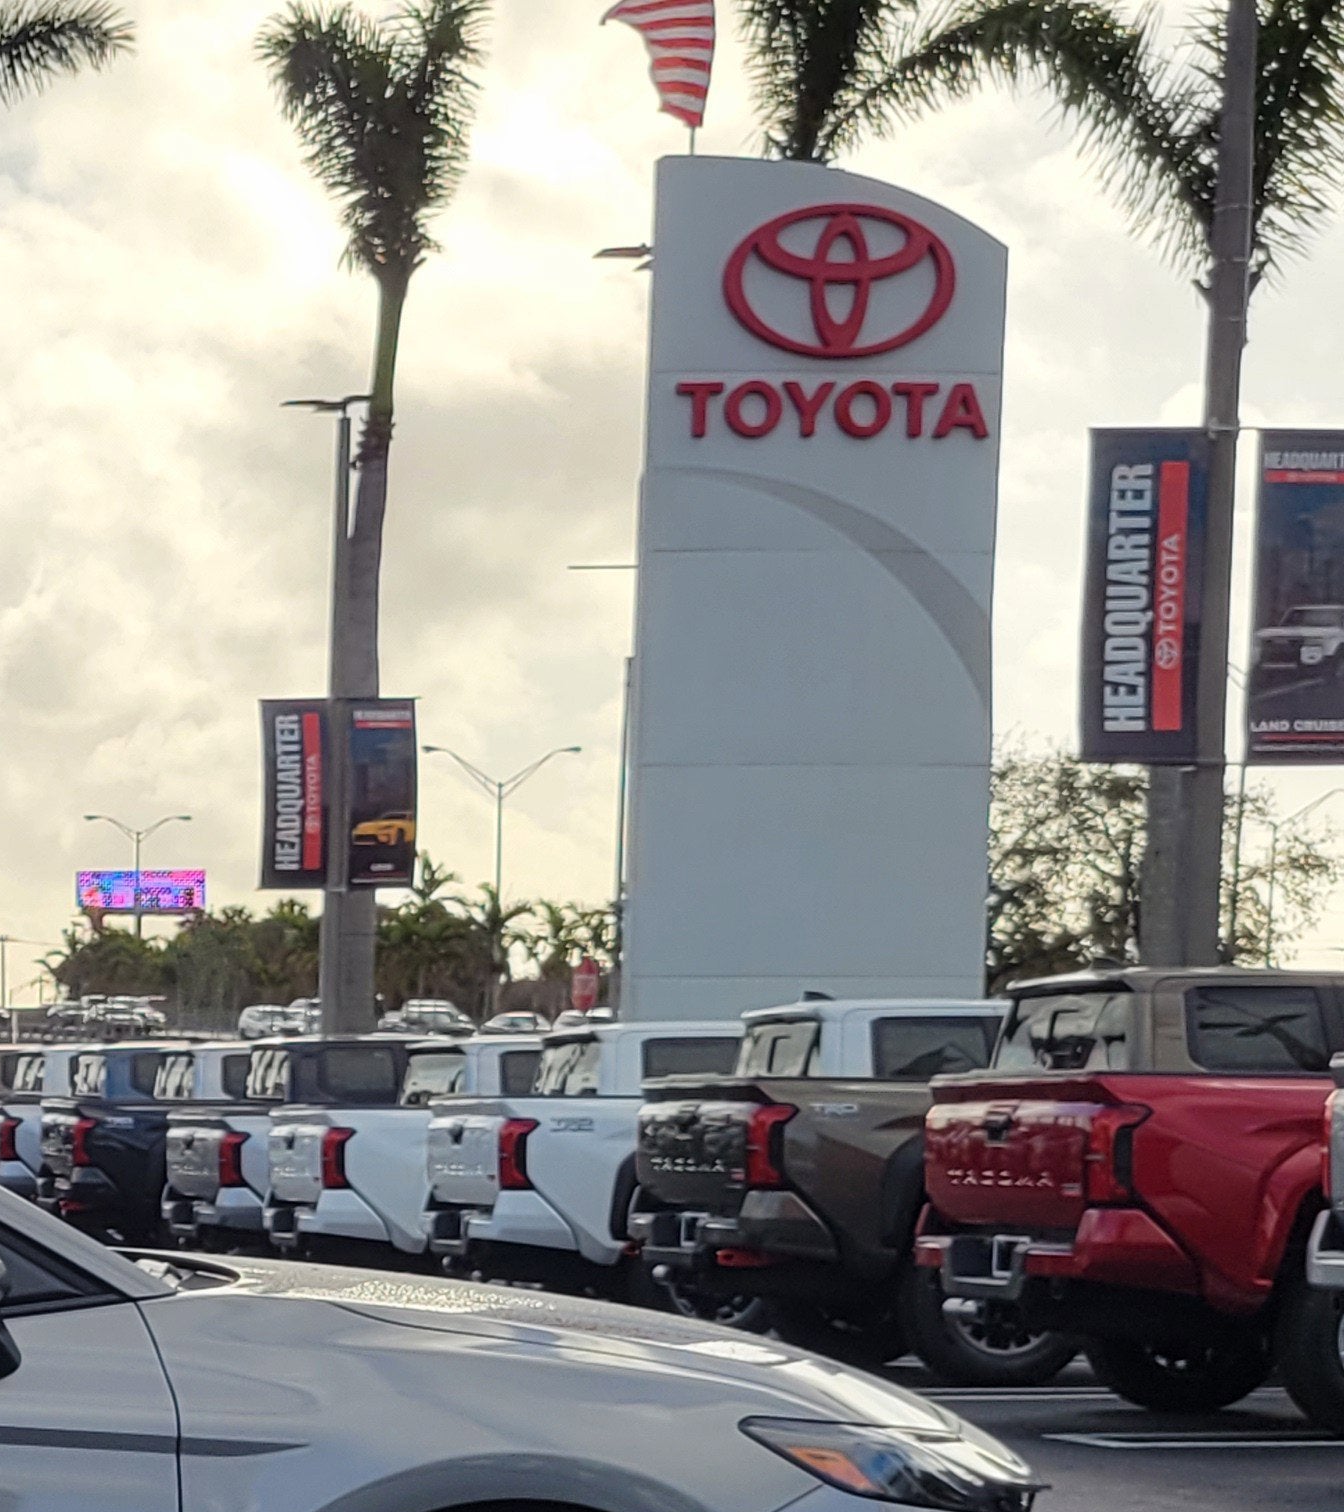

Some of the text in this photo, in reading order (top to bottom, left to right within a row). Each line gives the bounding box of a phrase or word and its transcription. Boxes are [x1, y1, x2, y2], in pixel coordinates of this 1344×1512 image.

[676, 380, 989, 438] TOYOTA
[1103, 463, 1154, 732] HEADQUARTER
[1158, 534, 1181, 636] TOYOTA
[1251, 720, 1290, 732] LAND
[275, 714, 305, 871] HEADQUARTER
[946, 1169, 1055, 1187] TACOMA
